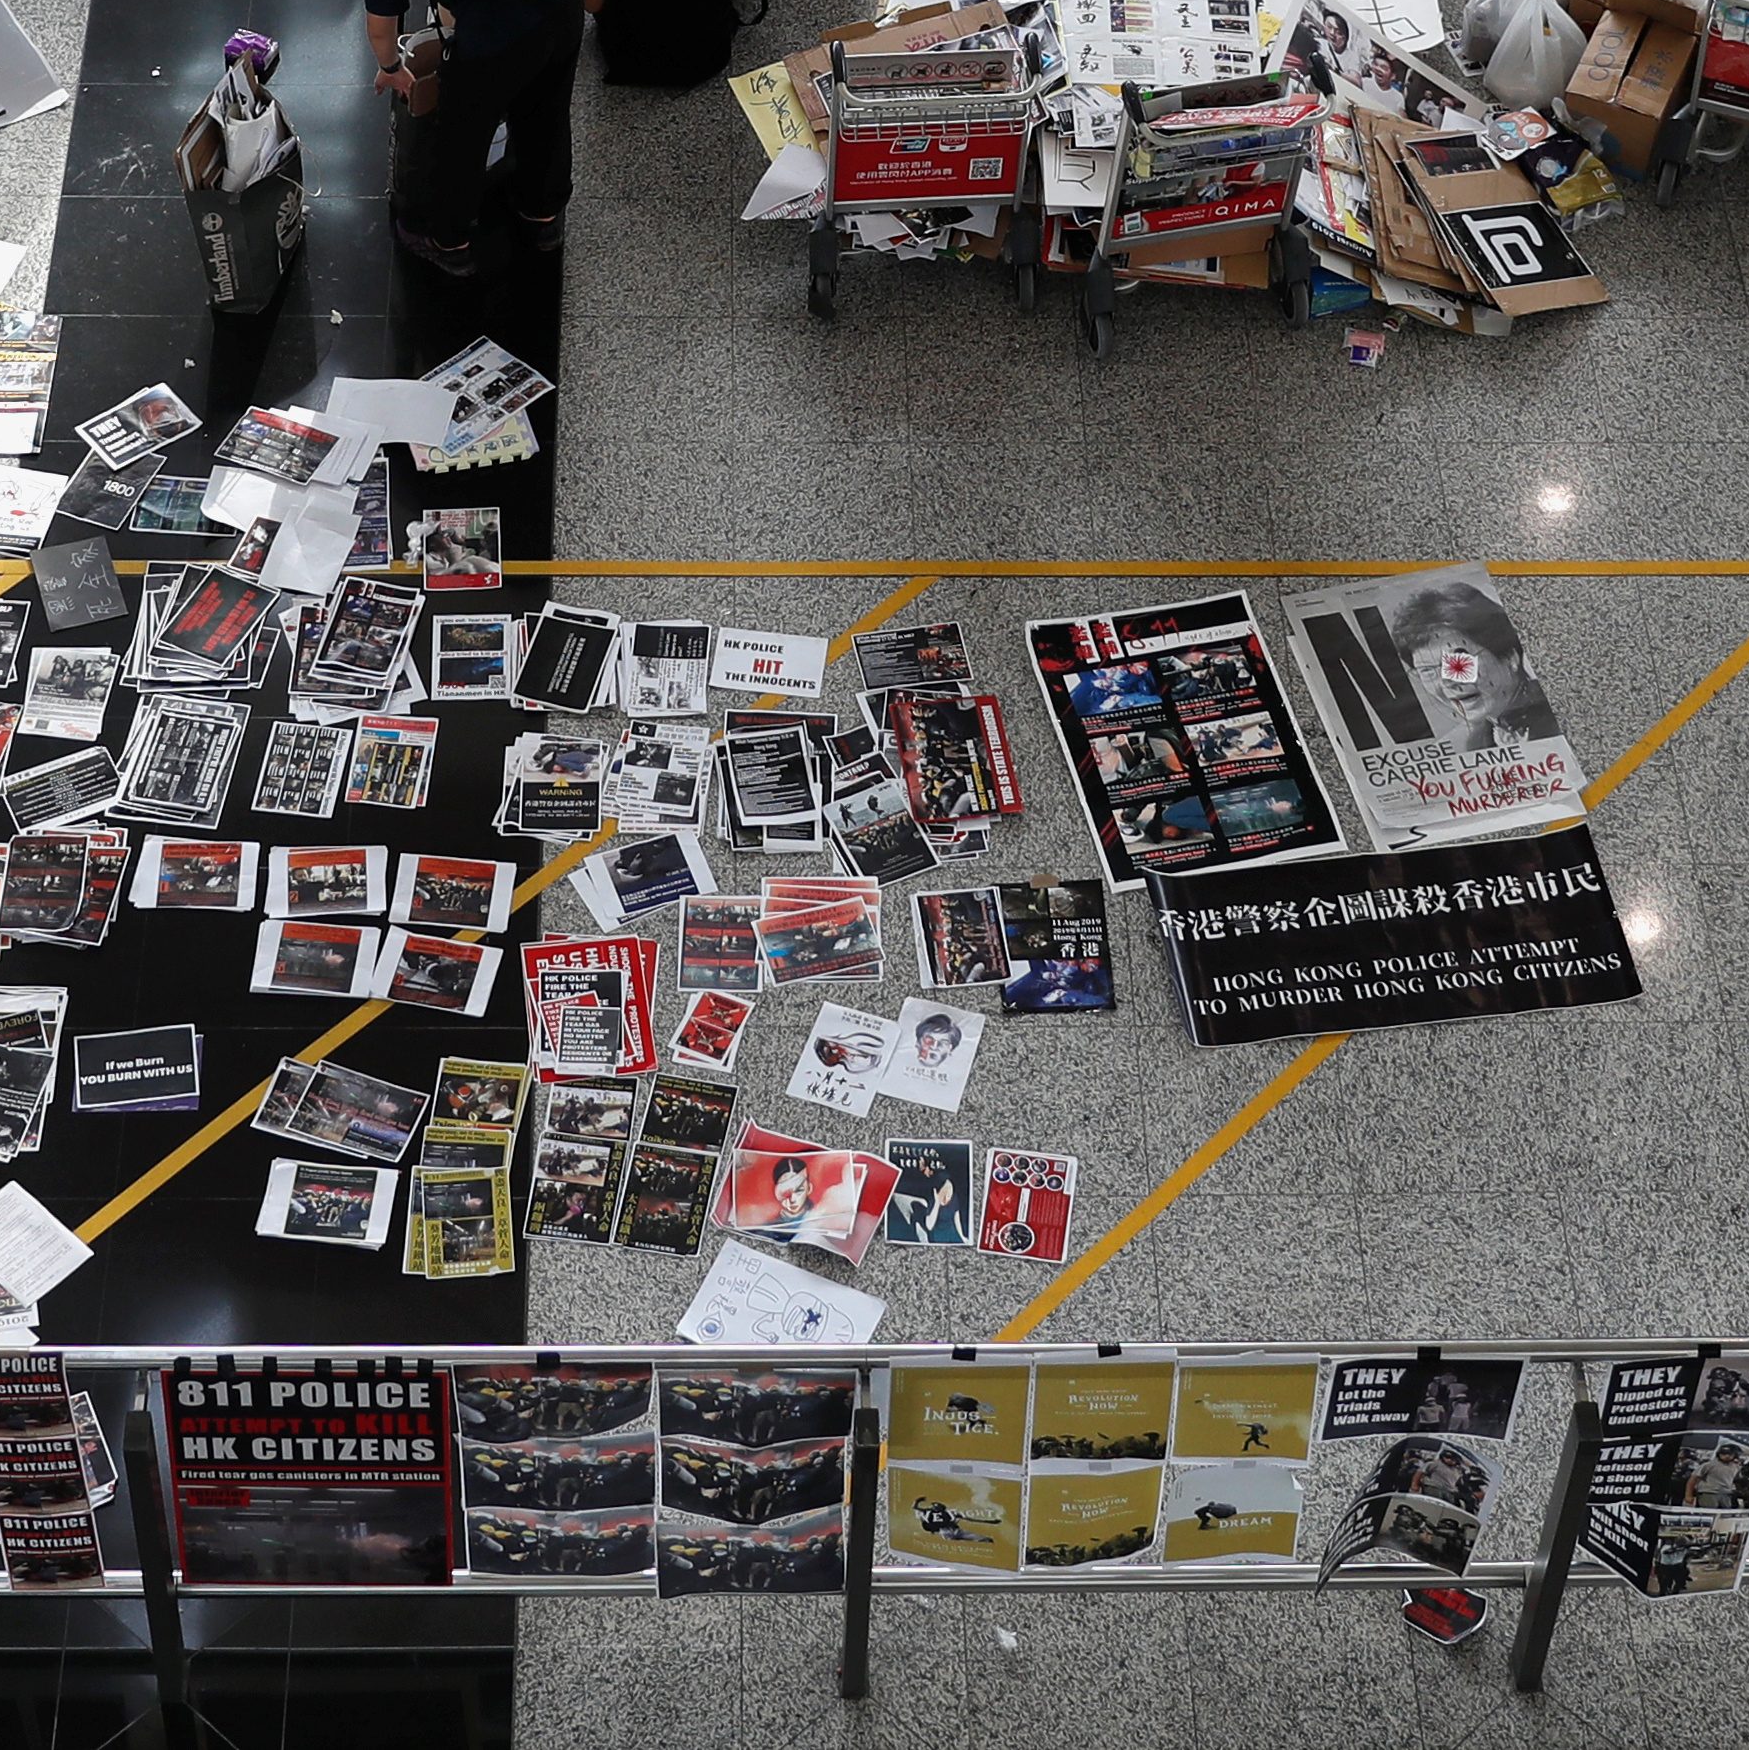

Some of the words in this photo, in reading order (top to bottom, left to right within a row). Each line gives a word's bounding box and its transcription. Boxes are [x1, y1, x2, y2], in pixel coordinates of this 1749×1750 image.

[1214, 196, 1277, 217] QIMA
[205, 232, 234, 303] Timberland
[103, 479, 135, 497] 1800
[723, 639, 741, 649] HK
[743, 642, 784, 654] POLICE
[752, 658, 783, 674] HIT
[724, 671, 748, 682] THE
[750, 675, 816, 690] INNOCENTS
[1303, 606, 1432, 750] N
[1362, 741, 1456, 772] EXCUSE
[1369, 759, 1456, 787] CARRIE
[1459, 745, 1525, 769] LAME
[1409, 775, 1455, 804] YOU
[1459, 753, 1566, 795] FUCKING
[539, 788, 583, 796] WARNING
[1450, 778, 1572, 817] MURDERER
[1160, 862, 1601, 941] 香港警察企圖謀殺香港市民
[1062, 919, 1080, 927] Aug
[1080, 934, 1103, 942] Kong
[1060, 942, 1100, 958] 香港
[1212, 968, 1284, 994] HONG
[1294, 962, 1362, 984] KONG
[1374, 952, 1458, 976] POLICE
[1469, 937, 1579, 966] ATTEMPT
[545, 983, 565, 991] FIRE
[1194, 998, 1228, 1017] TO
[1239, 985, 1343, 1013] MURDER
[1355, 977, 1424, 1000] HONG
[1437, 970, 1503, 991] KONG
[1514, 954, 1621, 984] CITIZENS
[116, 1060, 135, 1070] we
[136, 1055, 164, 1069] Burn
[80, 1073, 106, 1086] YOU
[108, 1070, 141, 1083] BURN
[143, 1066, 176, 1079] WITH
[177, 1064, 193, 1076] US
[1, 1357, 58, 1373] POLICE
[1343, 1368, 1407, 1386] THEY
[1619, 1366, 1682, 1388] THEY
[178, 1381, 252, 1407] 811
[270, 1382, 430, 1408] POLICE
[1337, 1389, 1361, 1402] Let
[1364, 1389, 1386, 1400] the
[1614, 1387, 1663, 1403] Ripped
[1665, 1386, 1686, 1397] off
[1335, 1400, 1381, 1413] Triads
[1611, 1398, 1687, 1414] Protestor's
[180, 1417, 303, 1434] ATTEMPT
[312, 1418, 346, 1434] TO
[356, 1413, 433, 1435] KILL
[1333, 1413, 1365, 1426] Walk
[1368, 1412, 1410, 1425] away
[1608, 1409, 1685, 1426] Underwear
[951, 1420, 1000, 1436] TICE.
[183, 1437, 239, 1460] HK
[252, 1437, 436, 1462] CITIZENS
[181, 1469, 216, 1479] Fired
[219, 1470, 247, 1479] tear
[250, 1471, 274, 1481] gas
[277, 1470, 342, 1480] canisters
[361, 1472, 390, 1481] MTR
[392, 1471, 440, 1481] station
[1218, 1515, 1272, 1530] DREAM
